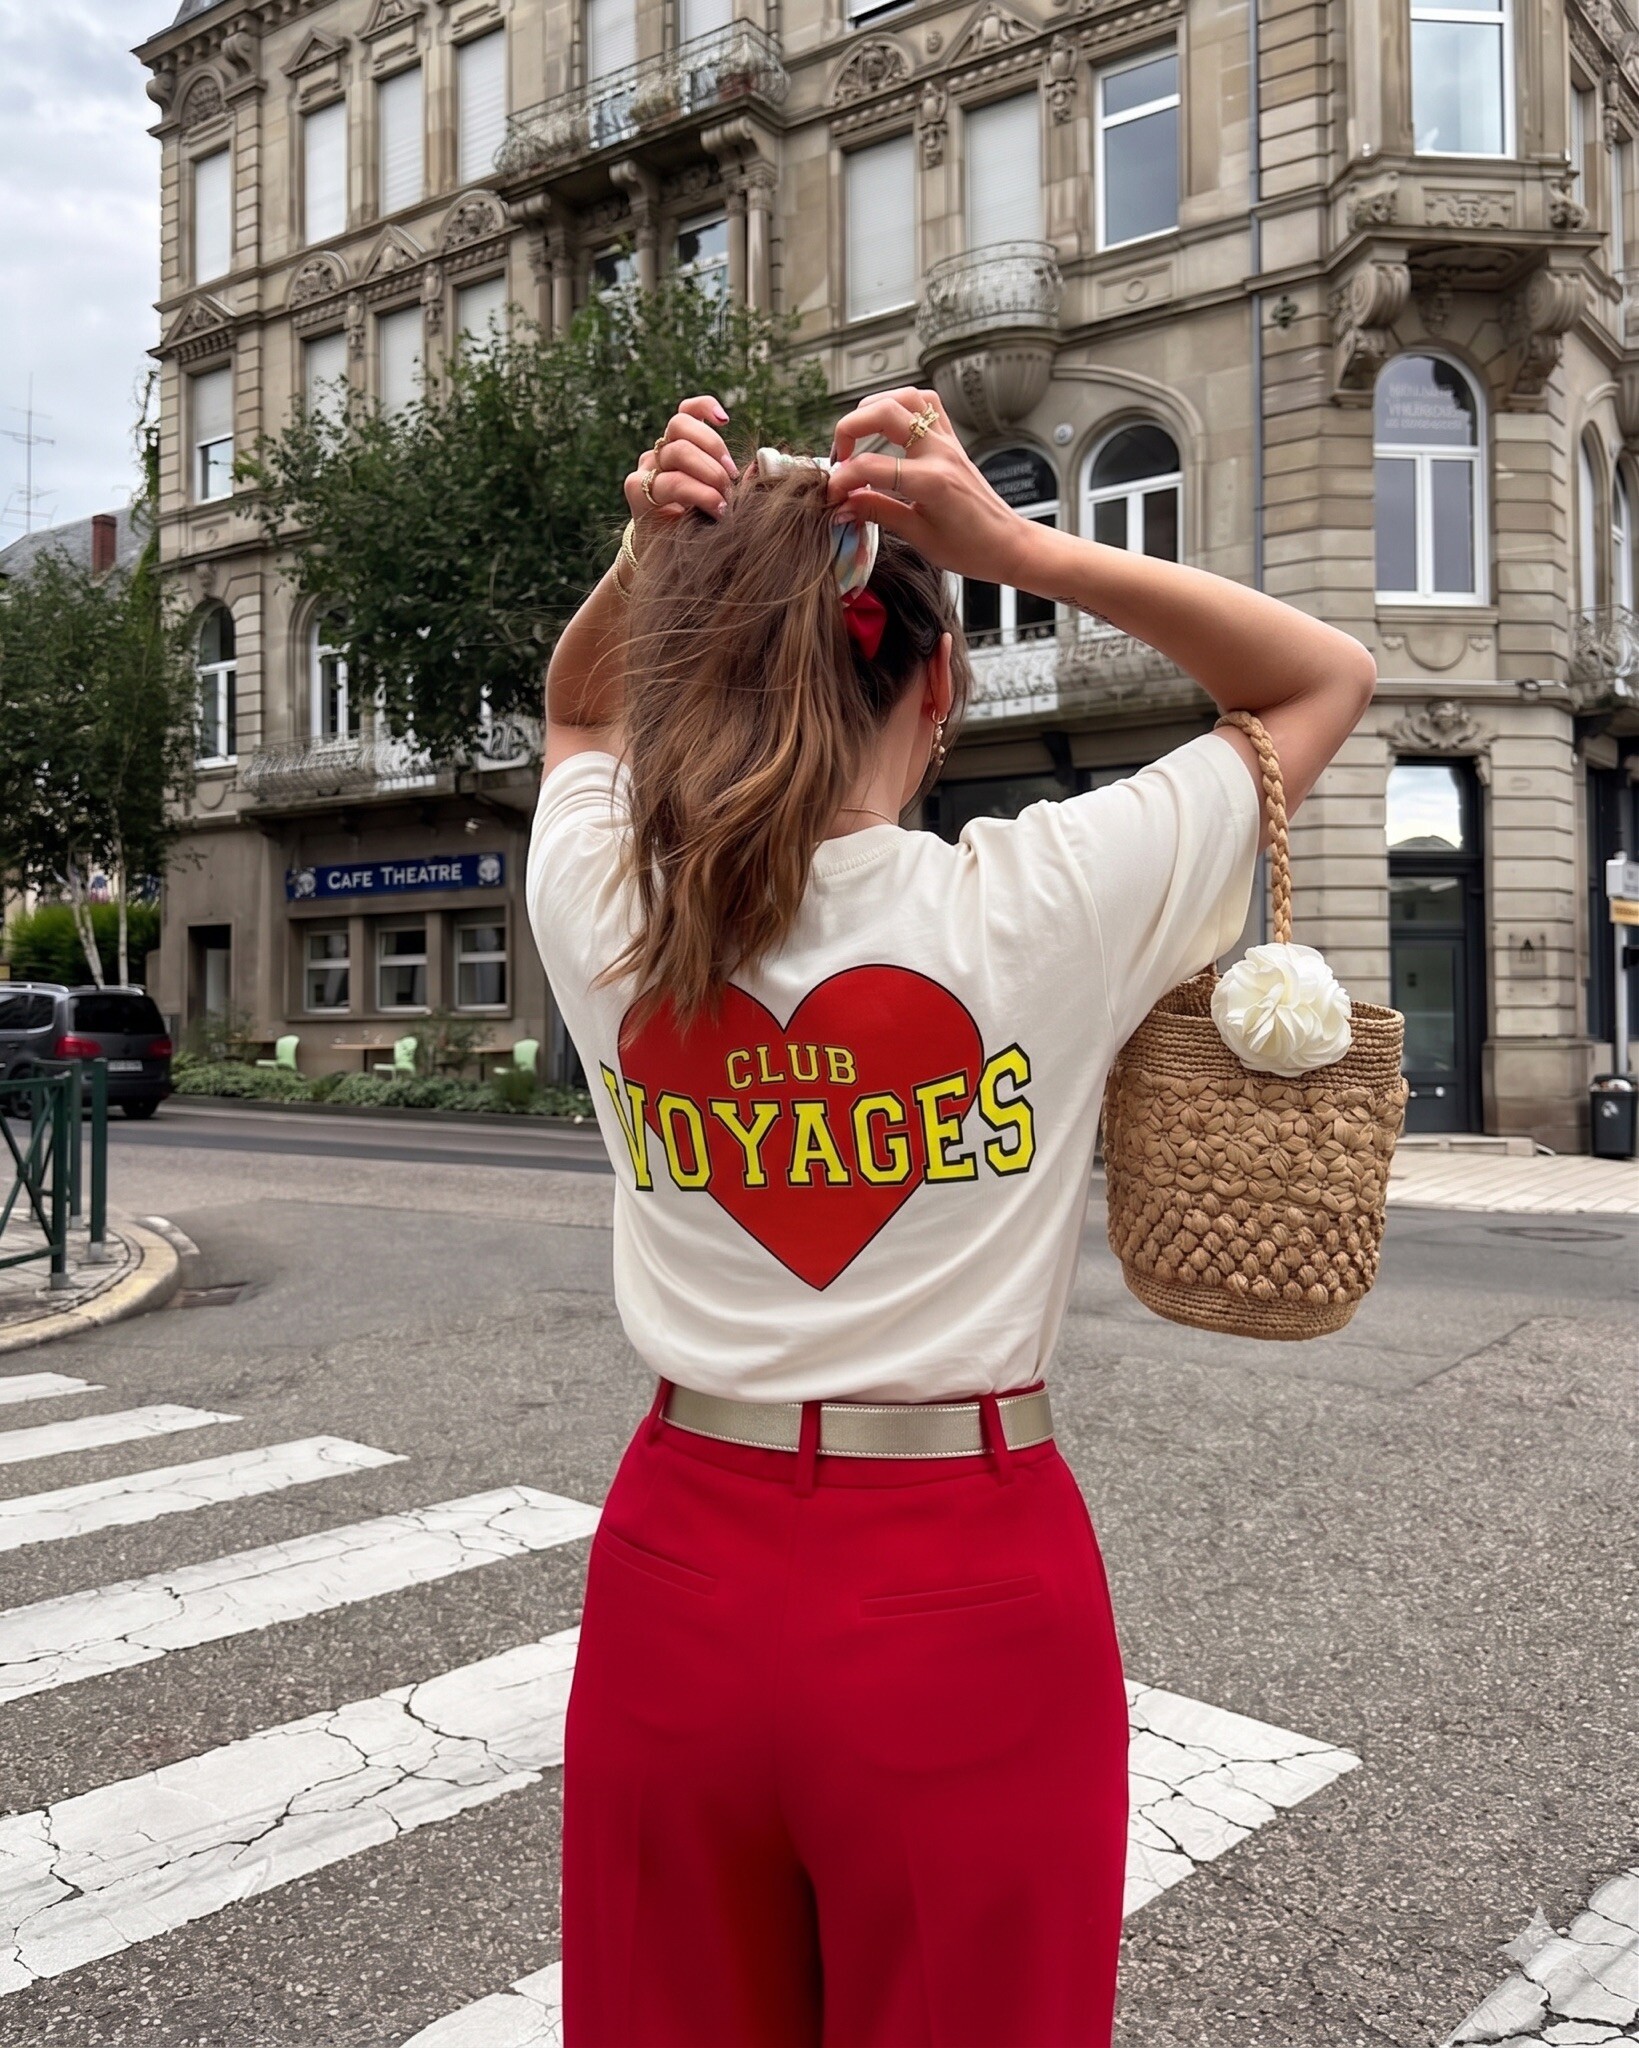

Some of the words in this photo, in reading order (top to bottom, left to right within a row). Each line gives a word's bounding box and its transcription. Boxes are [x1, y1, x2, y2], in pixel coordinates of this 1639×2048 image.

[380, 863, 462, 885] THEATRE
[726, 1044, 857, 1090] CLUB
[600, 1043, 1036, 1191] VOYAGES
